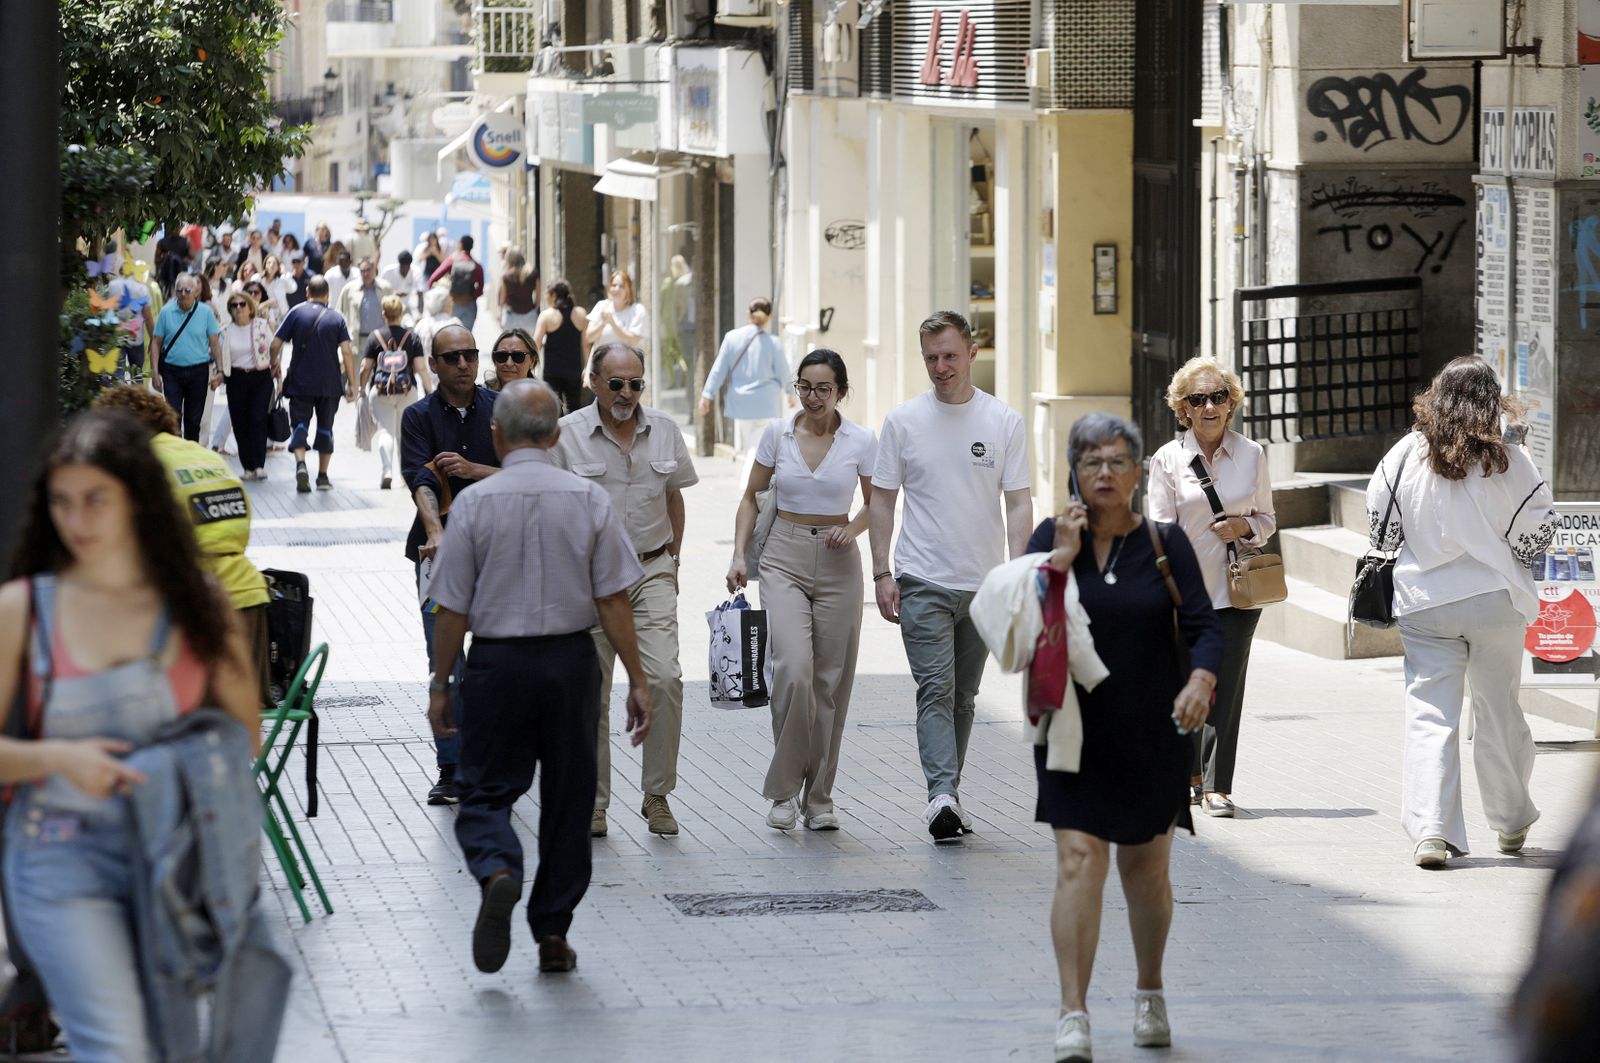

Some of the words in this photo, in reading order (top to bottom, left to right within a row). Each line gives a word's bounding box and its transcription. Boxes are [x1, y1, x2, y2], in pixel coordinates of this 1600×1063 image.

[487, 129, 521, 144] Snell
[1317, 218, 1467, 274] TOY!
[208, 500, 247, 518] ONCE
[1544, 586, 1559, 596] ctt
